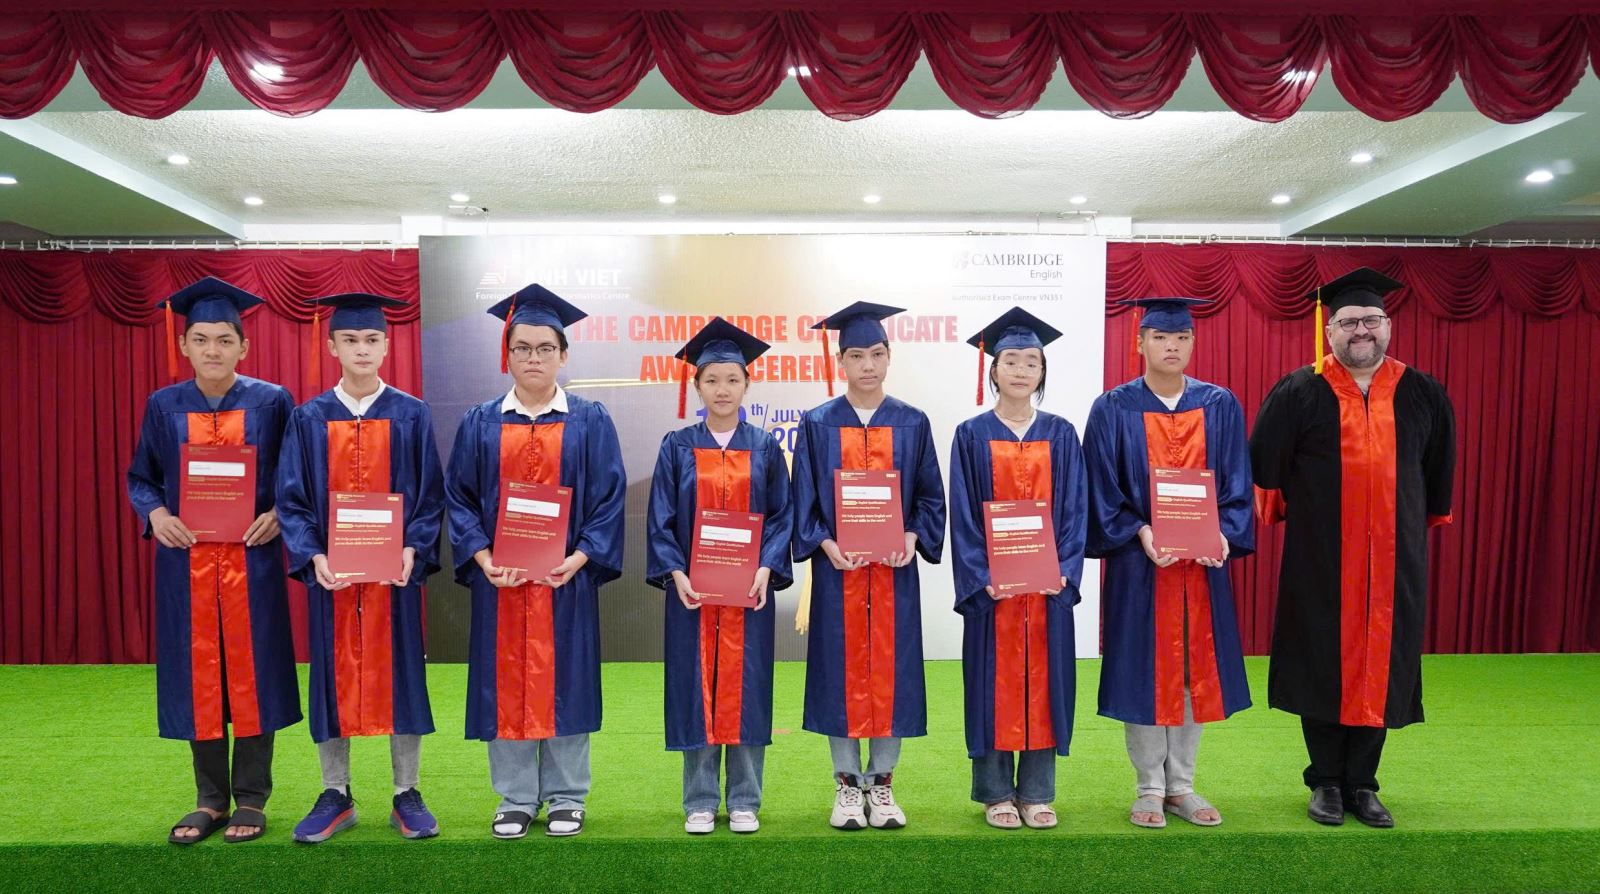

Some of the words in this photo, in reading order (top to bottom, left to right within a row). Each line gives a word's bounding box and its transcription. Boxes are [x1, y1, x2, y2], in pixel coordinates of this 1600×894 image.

[971, 253, 1064, 266] CAMBRIDGE
[575, 268, 622, 285] VIET
[1029, 269, 1063, 280] English
[993, 293, 1012, 301] Exam
[1013, 293, 1038, 301] Centre
[574, 314, 619, 342] THE
[628, 314, 788, 343] CAMBDGE
[771, 410, 806, 423] JULY
